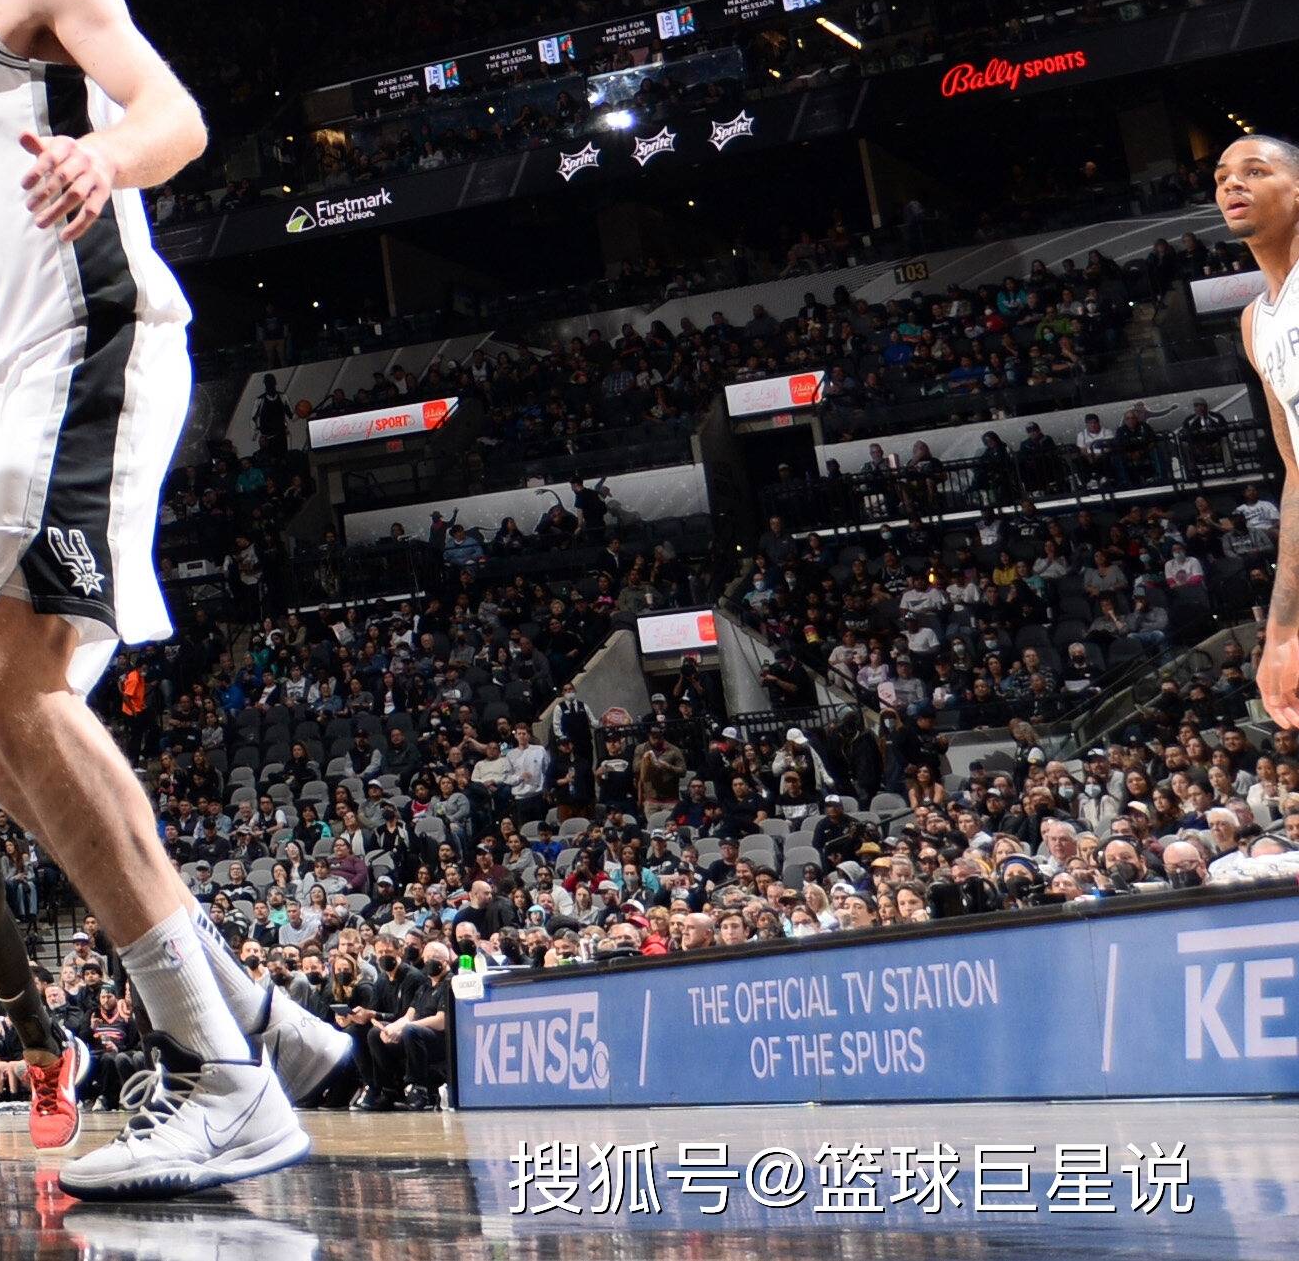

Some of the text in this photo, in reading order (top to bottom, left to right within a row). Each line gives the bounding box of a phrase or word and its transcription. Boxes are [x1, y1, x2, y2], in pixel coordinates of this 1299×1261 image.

[941, 51, 1086, 97] Bally SPORTS
[714, 121, 748, 140] Sprite
[637, 136, 670, 155] Sprite
[562, 153, 595, 172] Sprite
[316, 187, 393, 218] Firstmark
[319, 214, 345, 227] Credit
[895, 263, 927, 281] 103
[689, 958, 998, 1026] THE OFFICIAL TV STATION
[750, 1028, 925, 1079] OF THE SPURS
